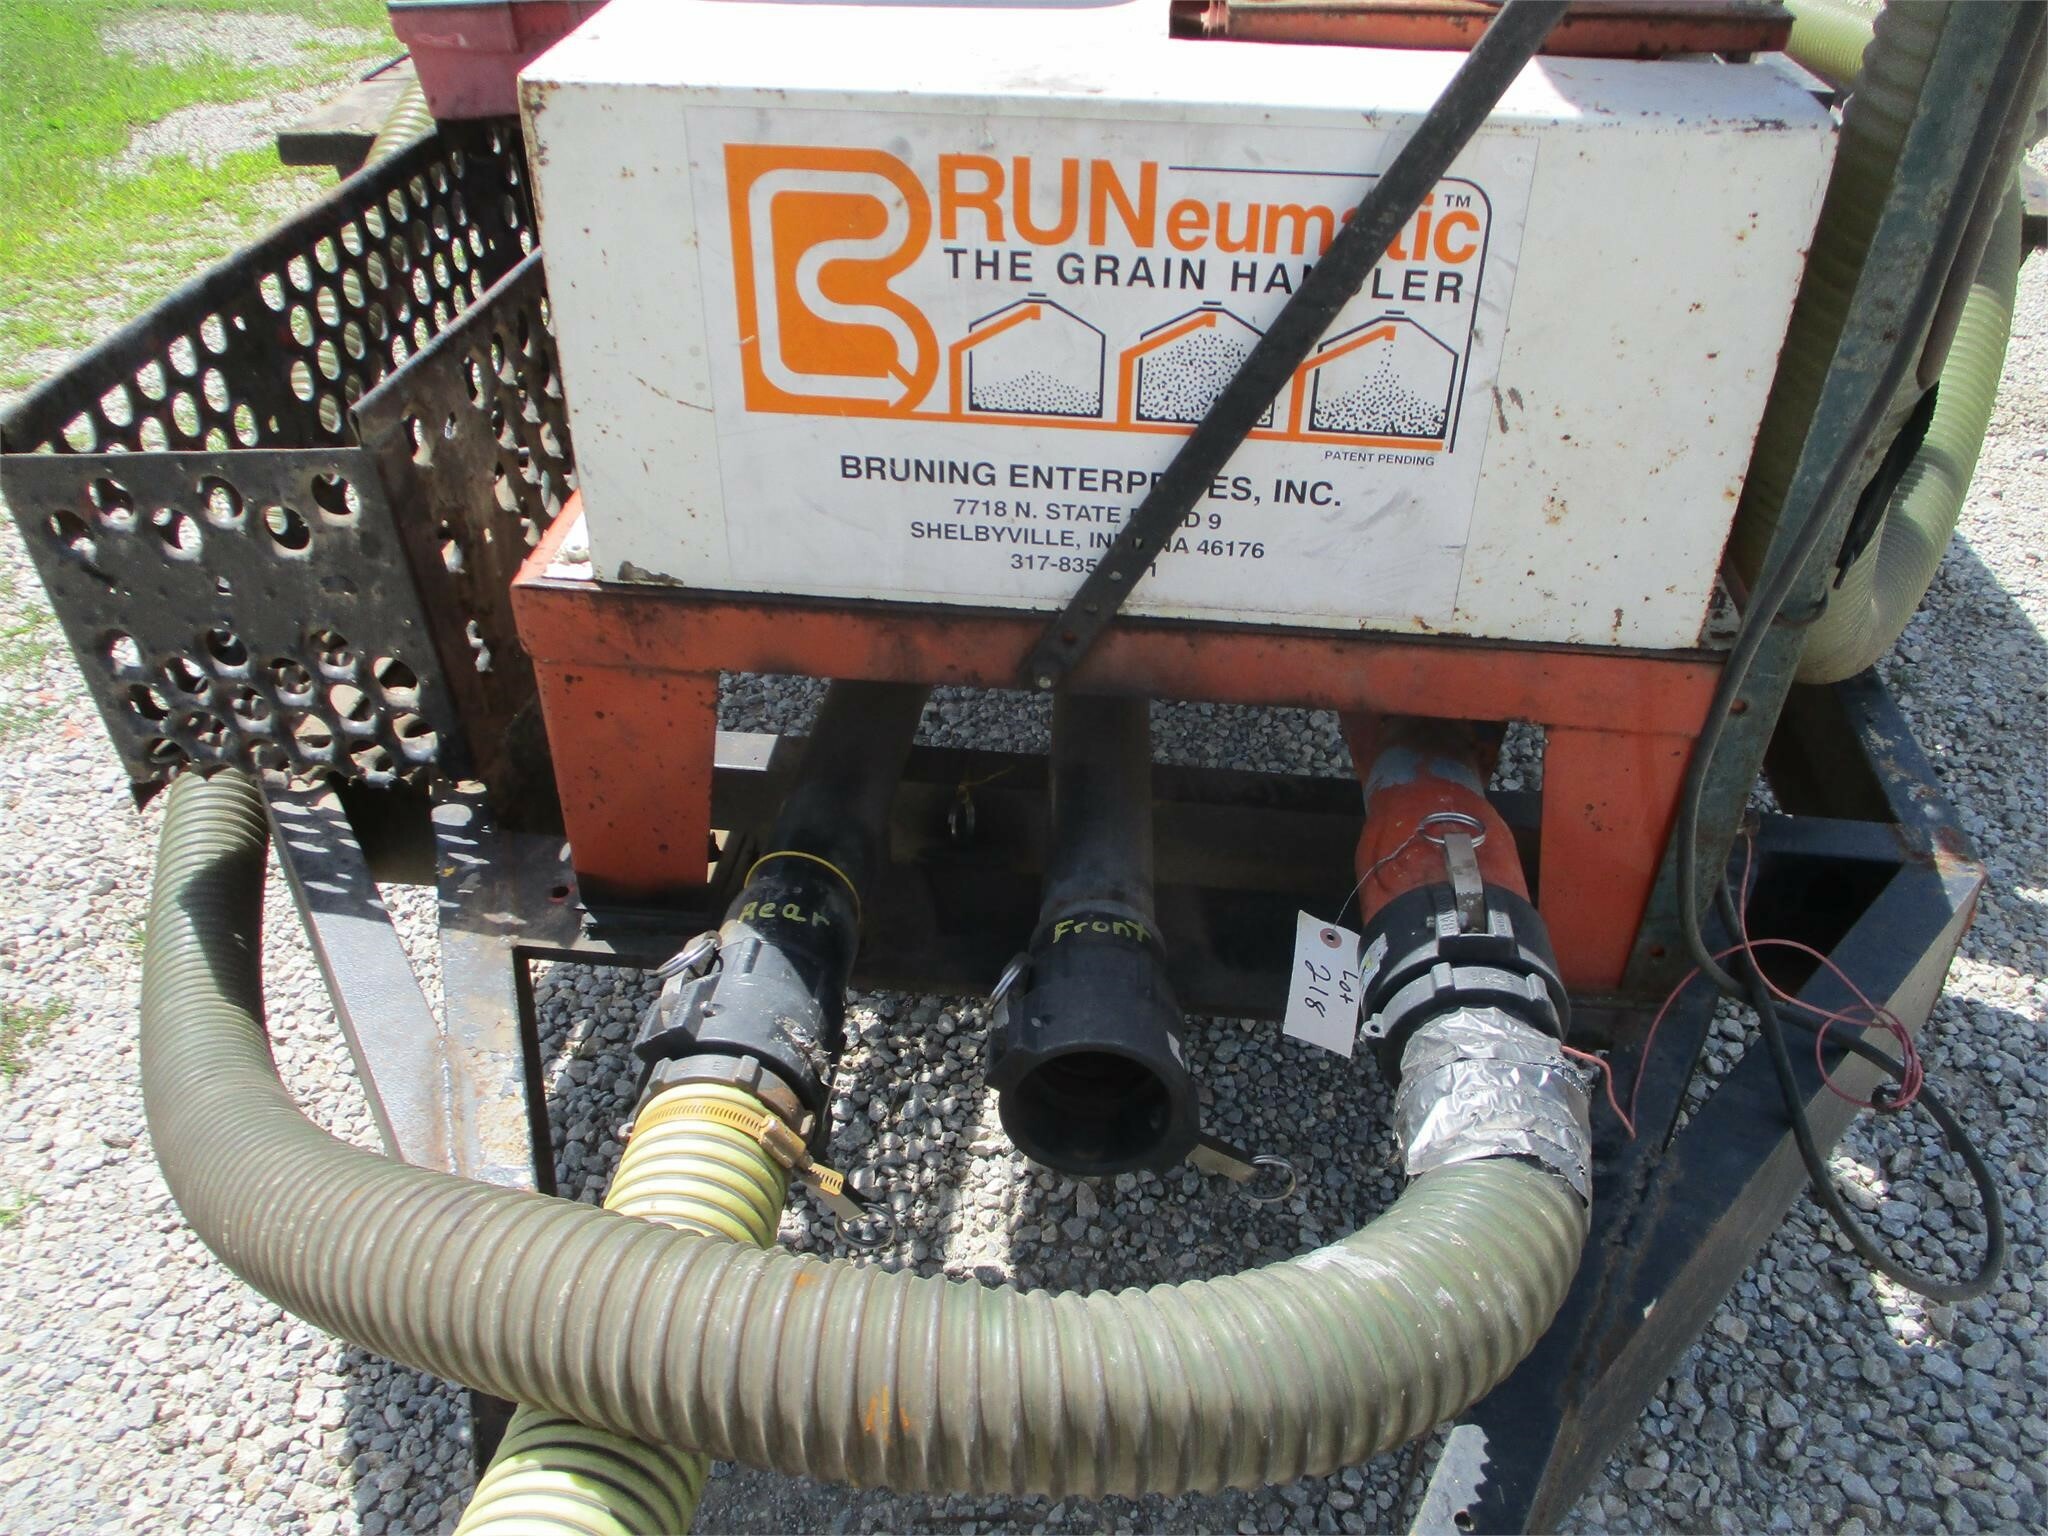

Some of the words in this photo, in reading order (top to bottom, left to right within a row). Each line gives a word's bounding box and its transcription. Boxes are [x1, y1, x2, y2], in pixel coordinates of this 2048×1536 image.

[943, 247, 1033, 282] THE
[1056, 252, 1206, 290] GRAIN
[1230, 260, 1465, 303] HALER
[1324, 450, 1375, 463] PATENT
[1377, 454, 1435, 467] PENDING
[841, 455, 996, 486] BRUNING
[1009, 464, 1260, 506] ENTERPES,
[1273, 479, 1341, 507] INC.
[953, 499, 1007, 518] 7718
[1015, 502, 1037, 519] N.
[1046, 503, 1121, 524] STATE
[1208, 513, 1222, 530] 9
[910, 521, 1081, 550] SHELBYVILLE,
[1197, 539, 1265, 558] 46176
[1052, 918, 1151, 944] Front
[1304, 960, 1331, 1018] 218
